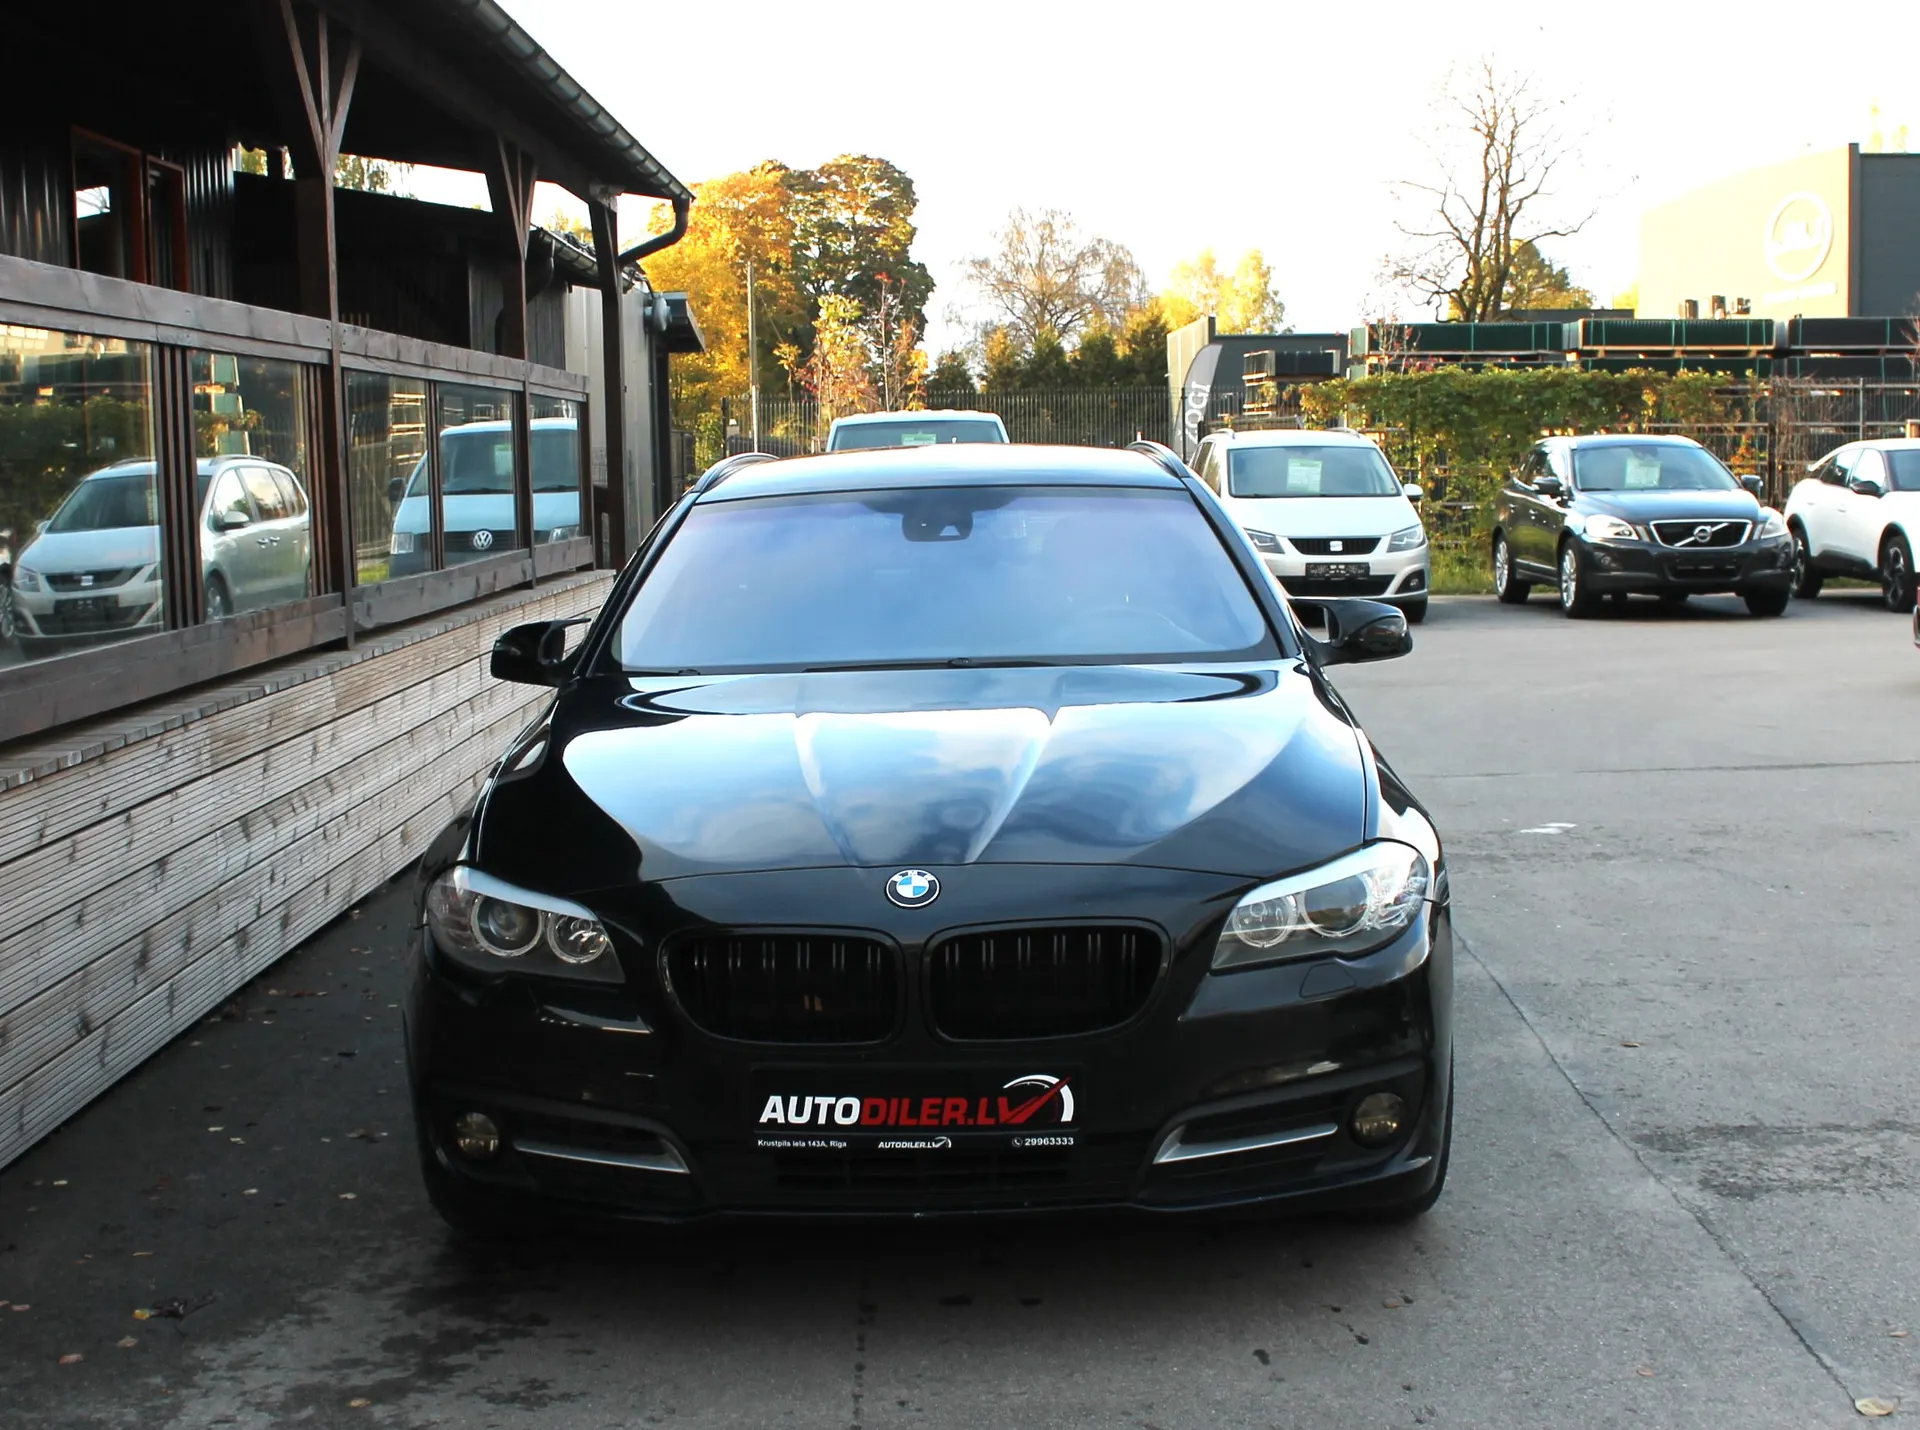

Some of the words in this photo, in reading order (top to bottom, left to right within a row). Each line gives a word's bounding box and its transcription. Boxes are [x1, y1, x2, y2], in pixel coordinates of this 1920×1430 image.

[759, 1077, 1071, 1125] AUTODILER.LV
[757, 1139, 791, 1148] Krustpils
[1024, 1137, 1074, 1146] 29963333
